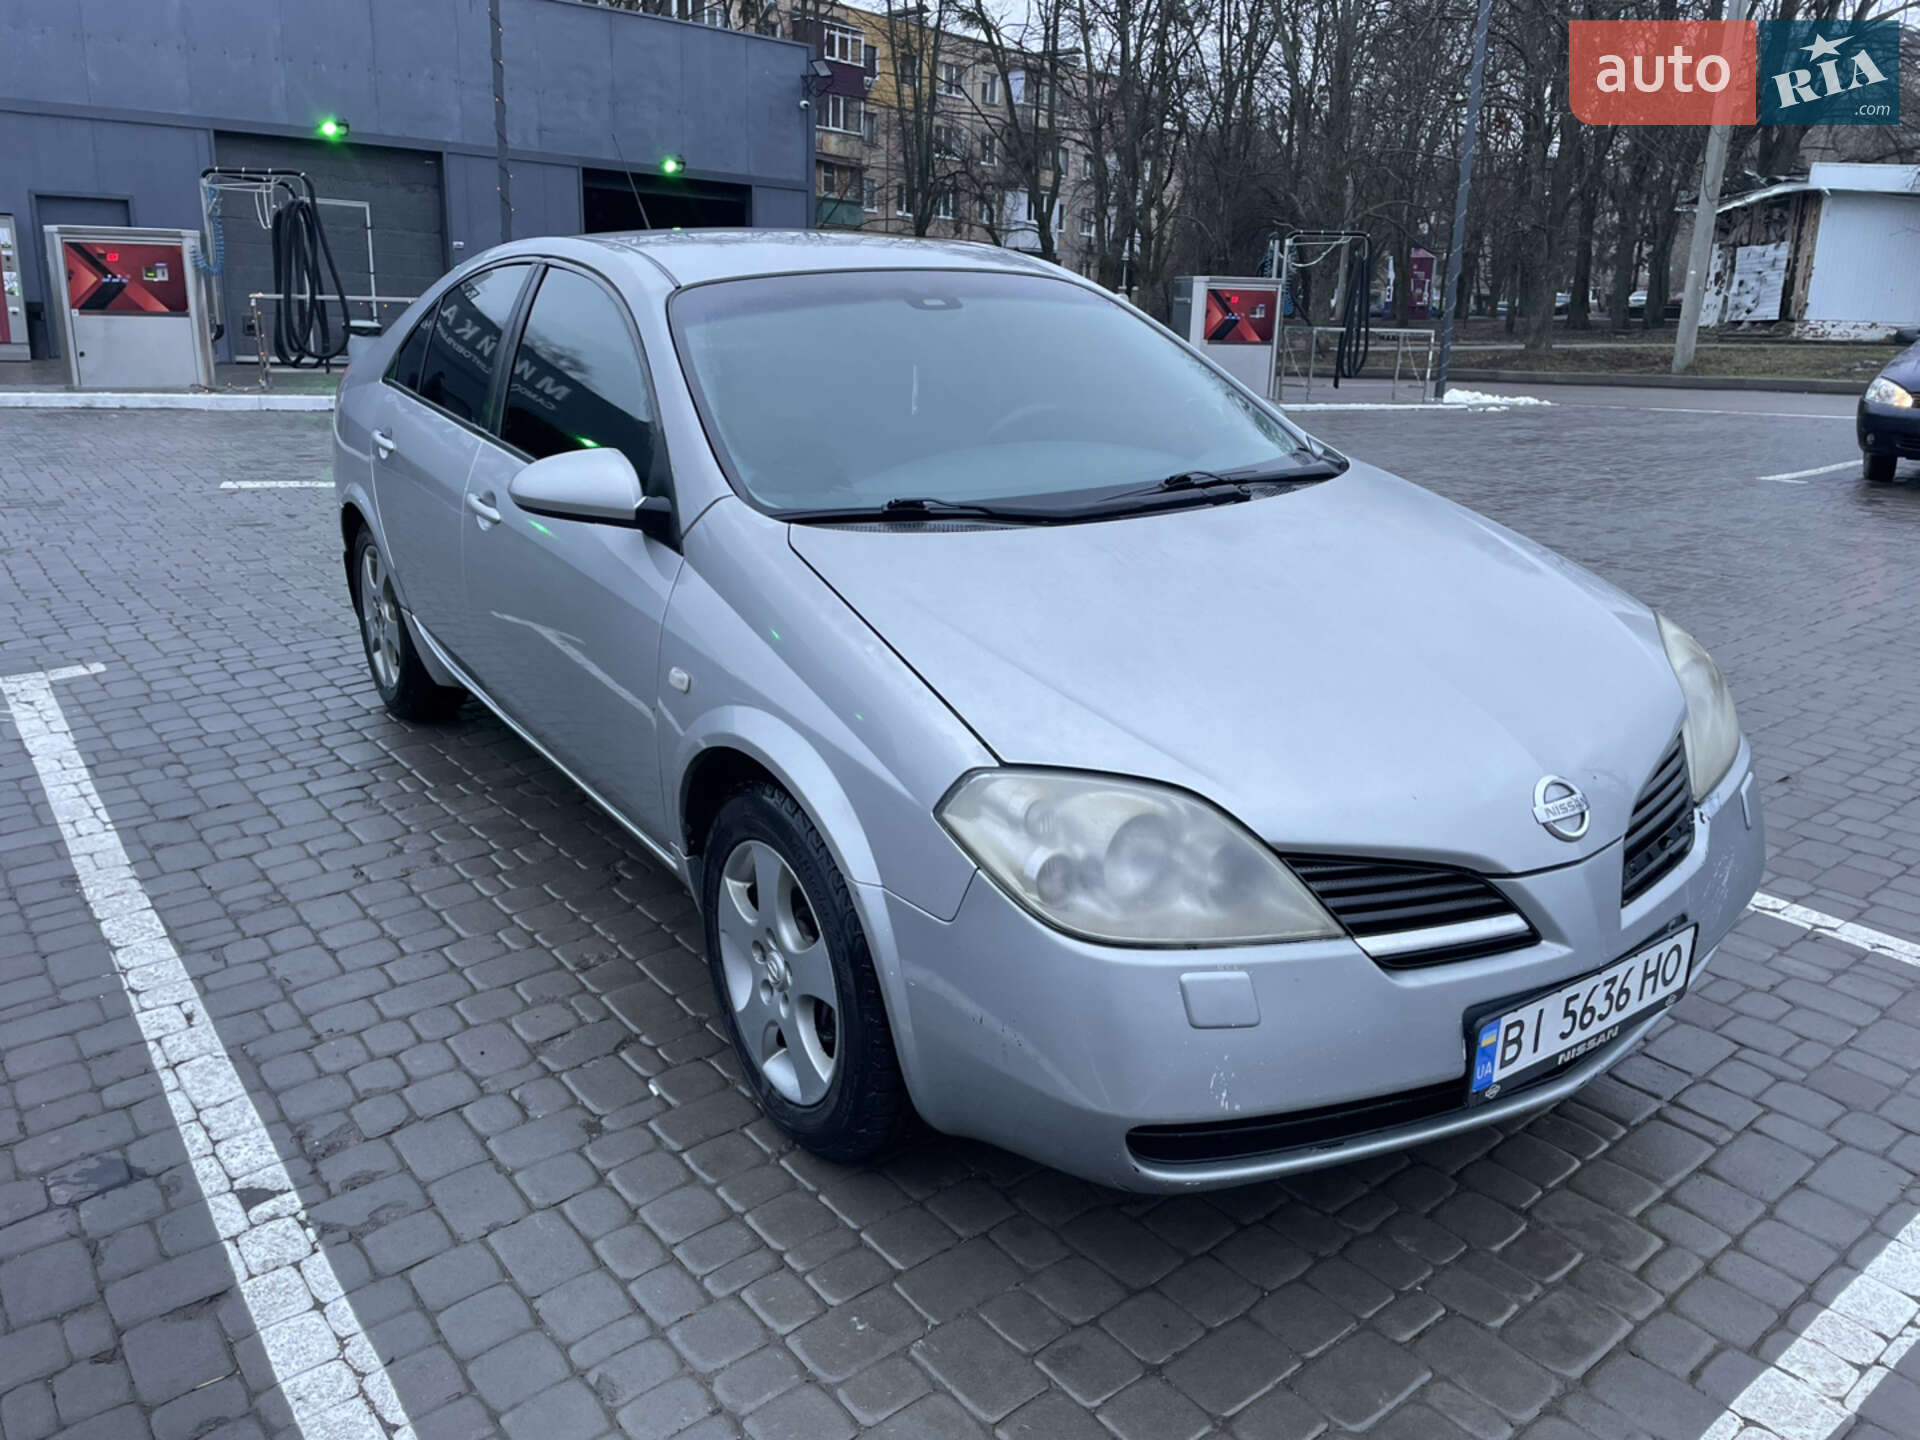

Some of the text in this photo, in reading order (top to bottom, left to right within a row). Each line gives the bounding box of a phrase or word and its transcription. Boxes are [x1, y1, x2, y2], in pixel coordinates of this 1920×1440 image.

[1500, 943, 1682, 1070] BI 5636 HO
[1557, 1025, 1619, 1065] NISSAN
[1476, 1061, 1492, 1080] UA
